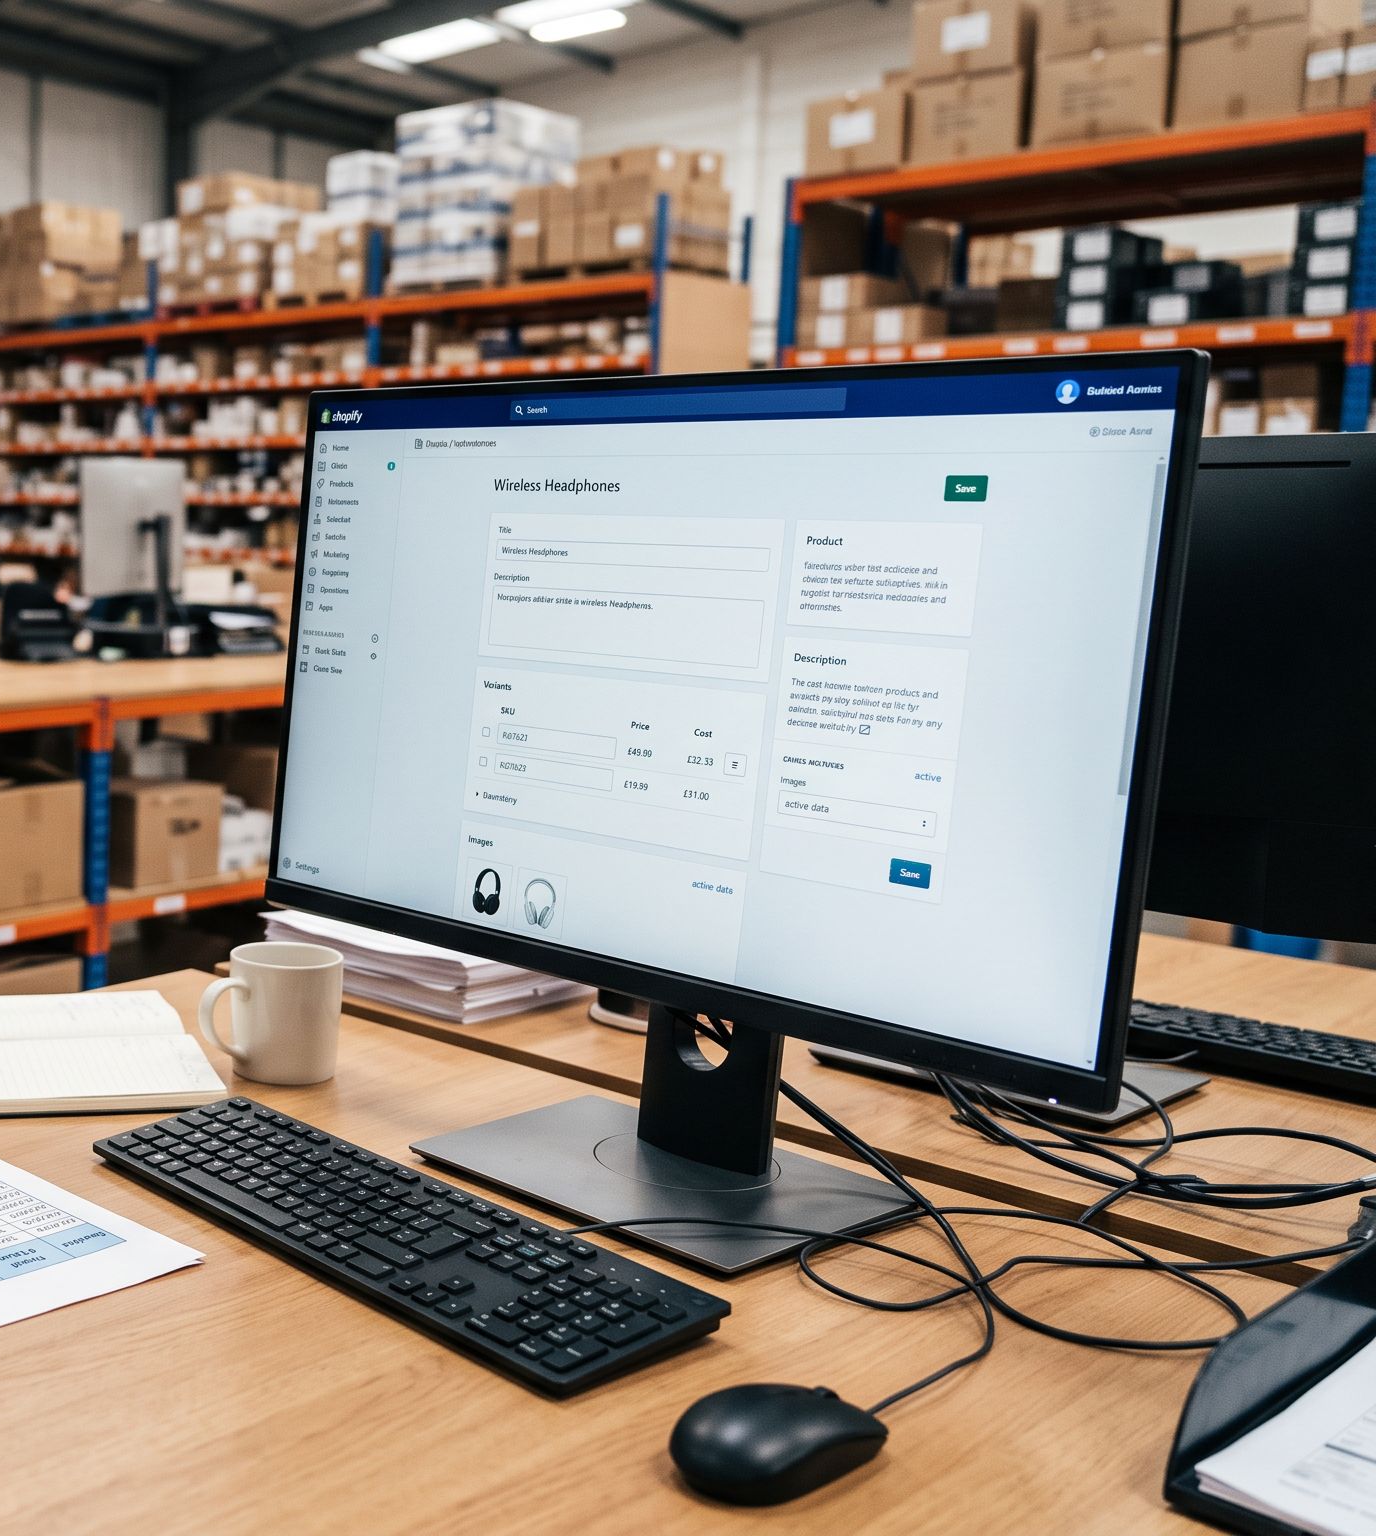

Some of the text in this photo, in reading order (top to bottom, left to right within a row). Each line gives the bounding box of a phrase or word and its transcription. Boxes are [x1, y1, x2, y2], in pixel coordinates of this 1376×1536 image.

[332, 410, 362, 423] shopify
[494, 479, 620, 494] Wireless Headphones
[955, 485, 976, 493] Save
[807, 536, 843, 546] Product
[922, 567, 938, 575] and
[931, 596, 946, 604] and
[794, 653, 847, 666] Description
[792, 678, 805, 687] The
[922, 691, 938, 699] and
[501, 707, 515, 715] SKU
[631, 722, 712, 738] Price Cost
[781, 777, 806, 787] Images
[915, 773, 941, 782] active
[683, 790, 709, 800] £31.00
[785, 800, 829, 814] active data
[468, 835, 493, 847] Images
